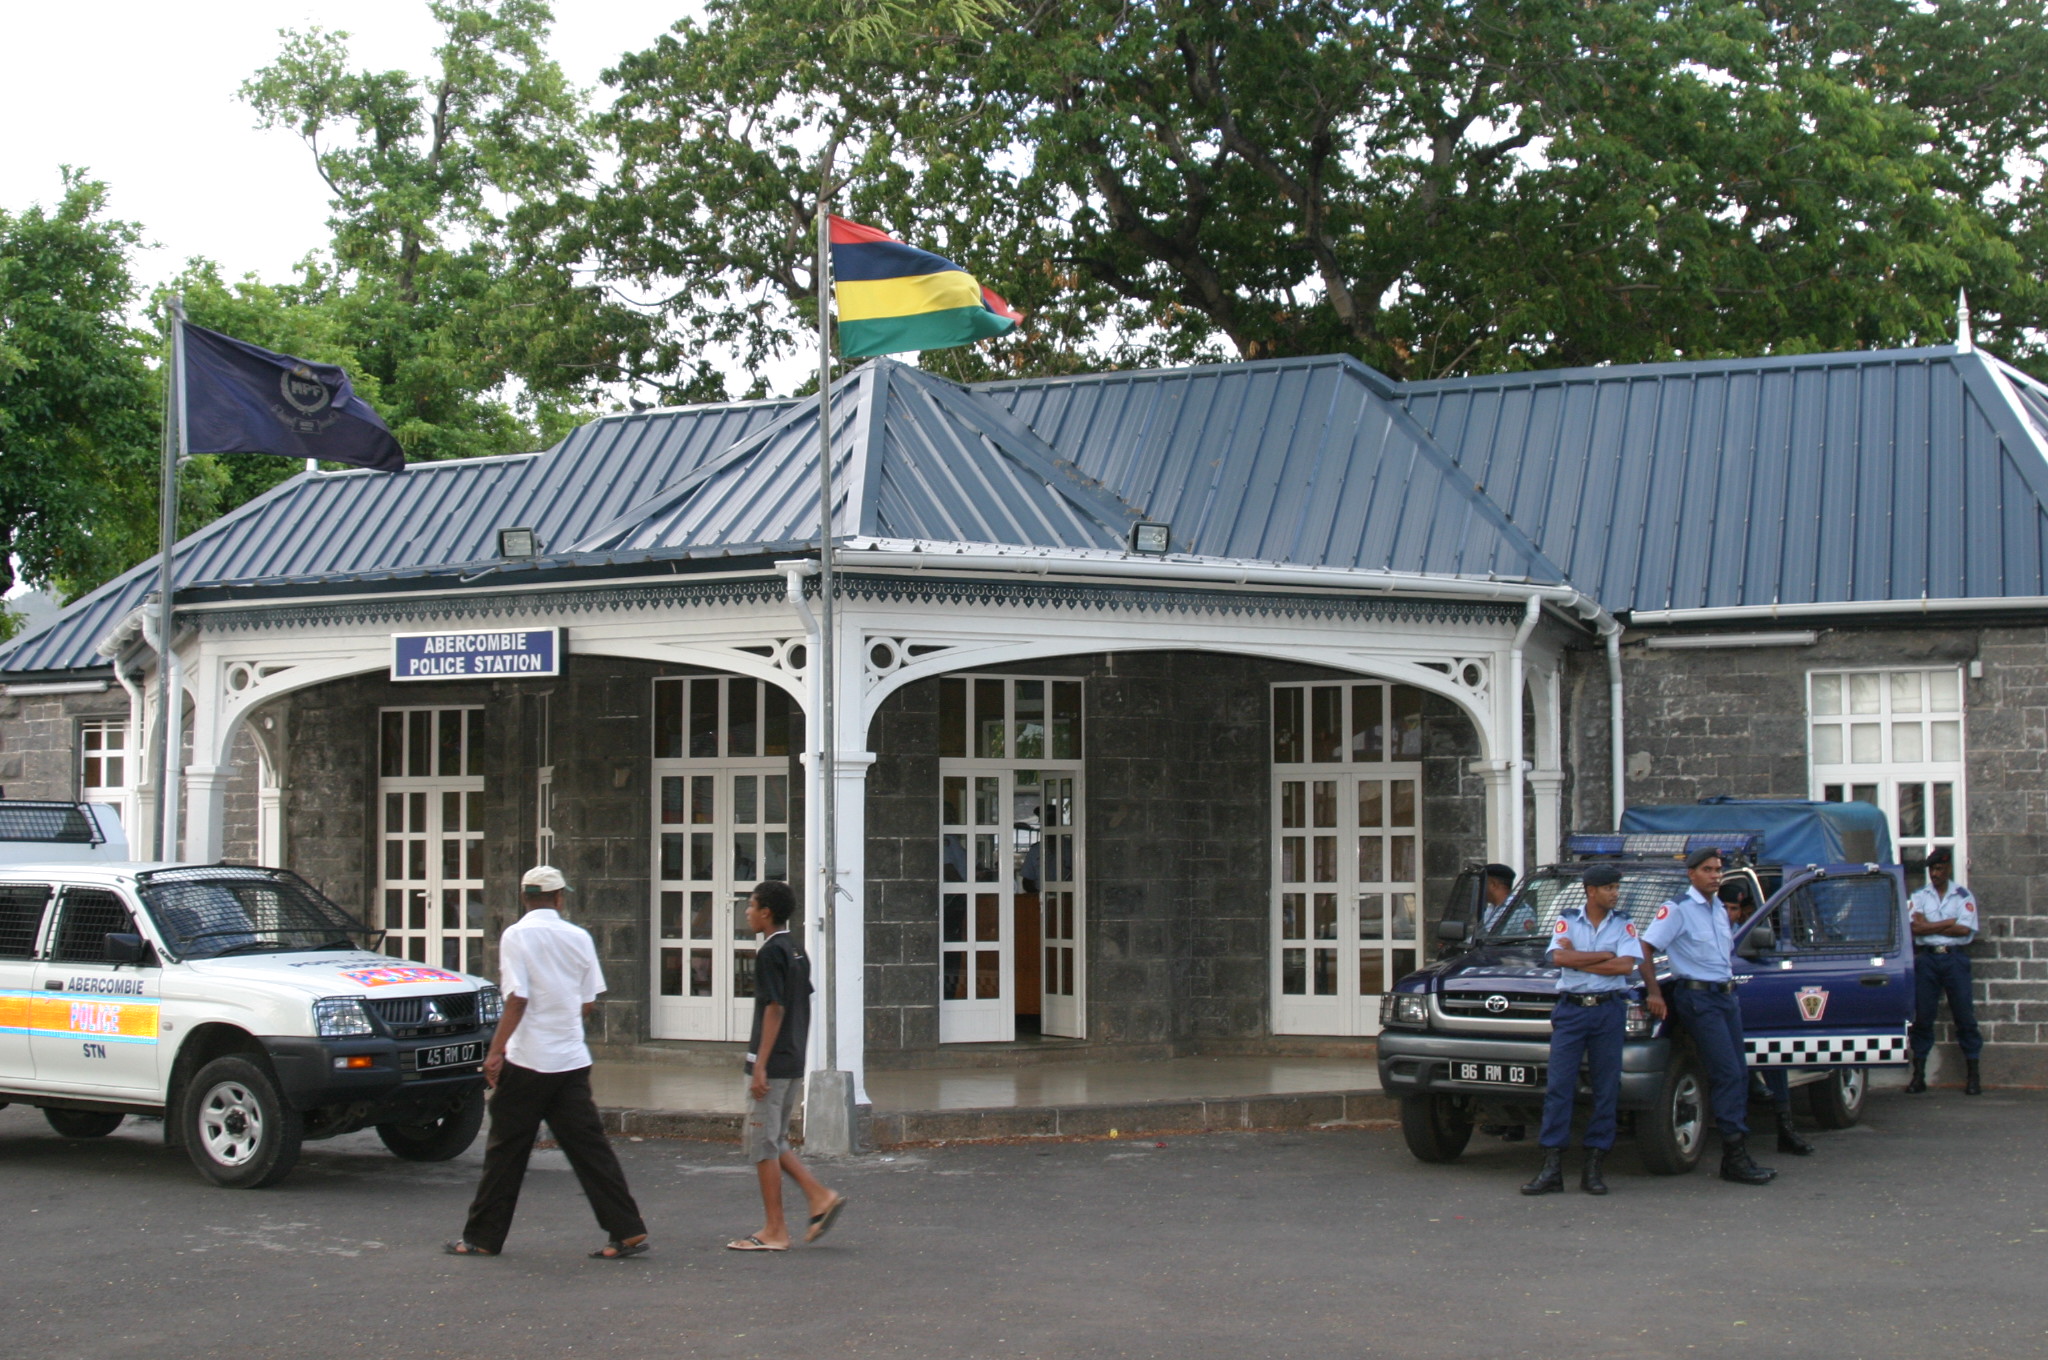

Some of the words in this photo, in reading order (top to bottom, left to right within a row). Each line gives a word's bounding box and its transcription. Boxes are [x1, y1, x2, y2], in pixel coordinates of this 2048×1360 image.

[424, 633, 527, 654] ABERCOMBIE
[409, 656, 466, 675] POLICE
[474, 653, 541, 673] STATION
[1460, 966, 1560, 978] POLICE
[68, 976, 145, 995] ABERCOMBIE
[70, 1002, 119, 1032] POLICE
[82, 1043, 106, 1059] STN
[427, 1049, 441, 1065] 45
[444, 1046, 458, 1063] RM
[462, 1044, 475, 1060] 07
[1461, 1064, 1477, 1079] 86
[1485, 1065, 1502, 1081] RM
[1509, 1067, 1525, 1083] 03
